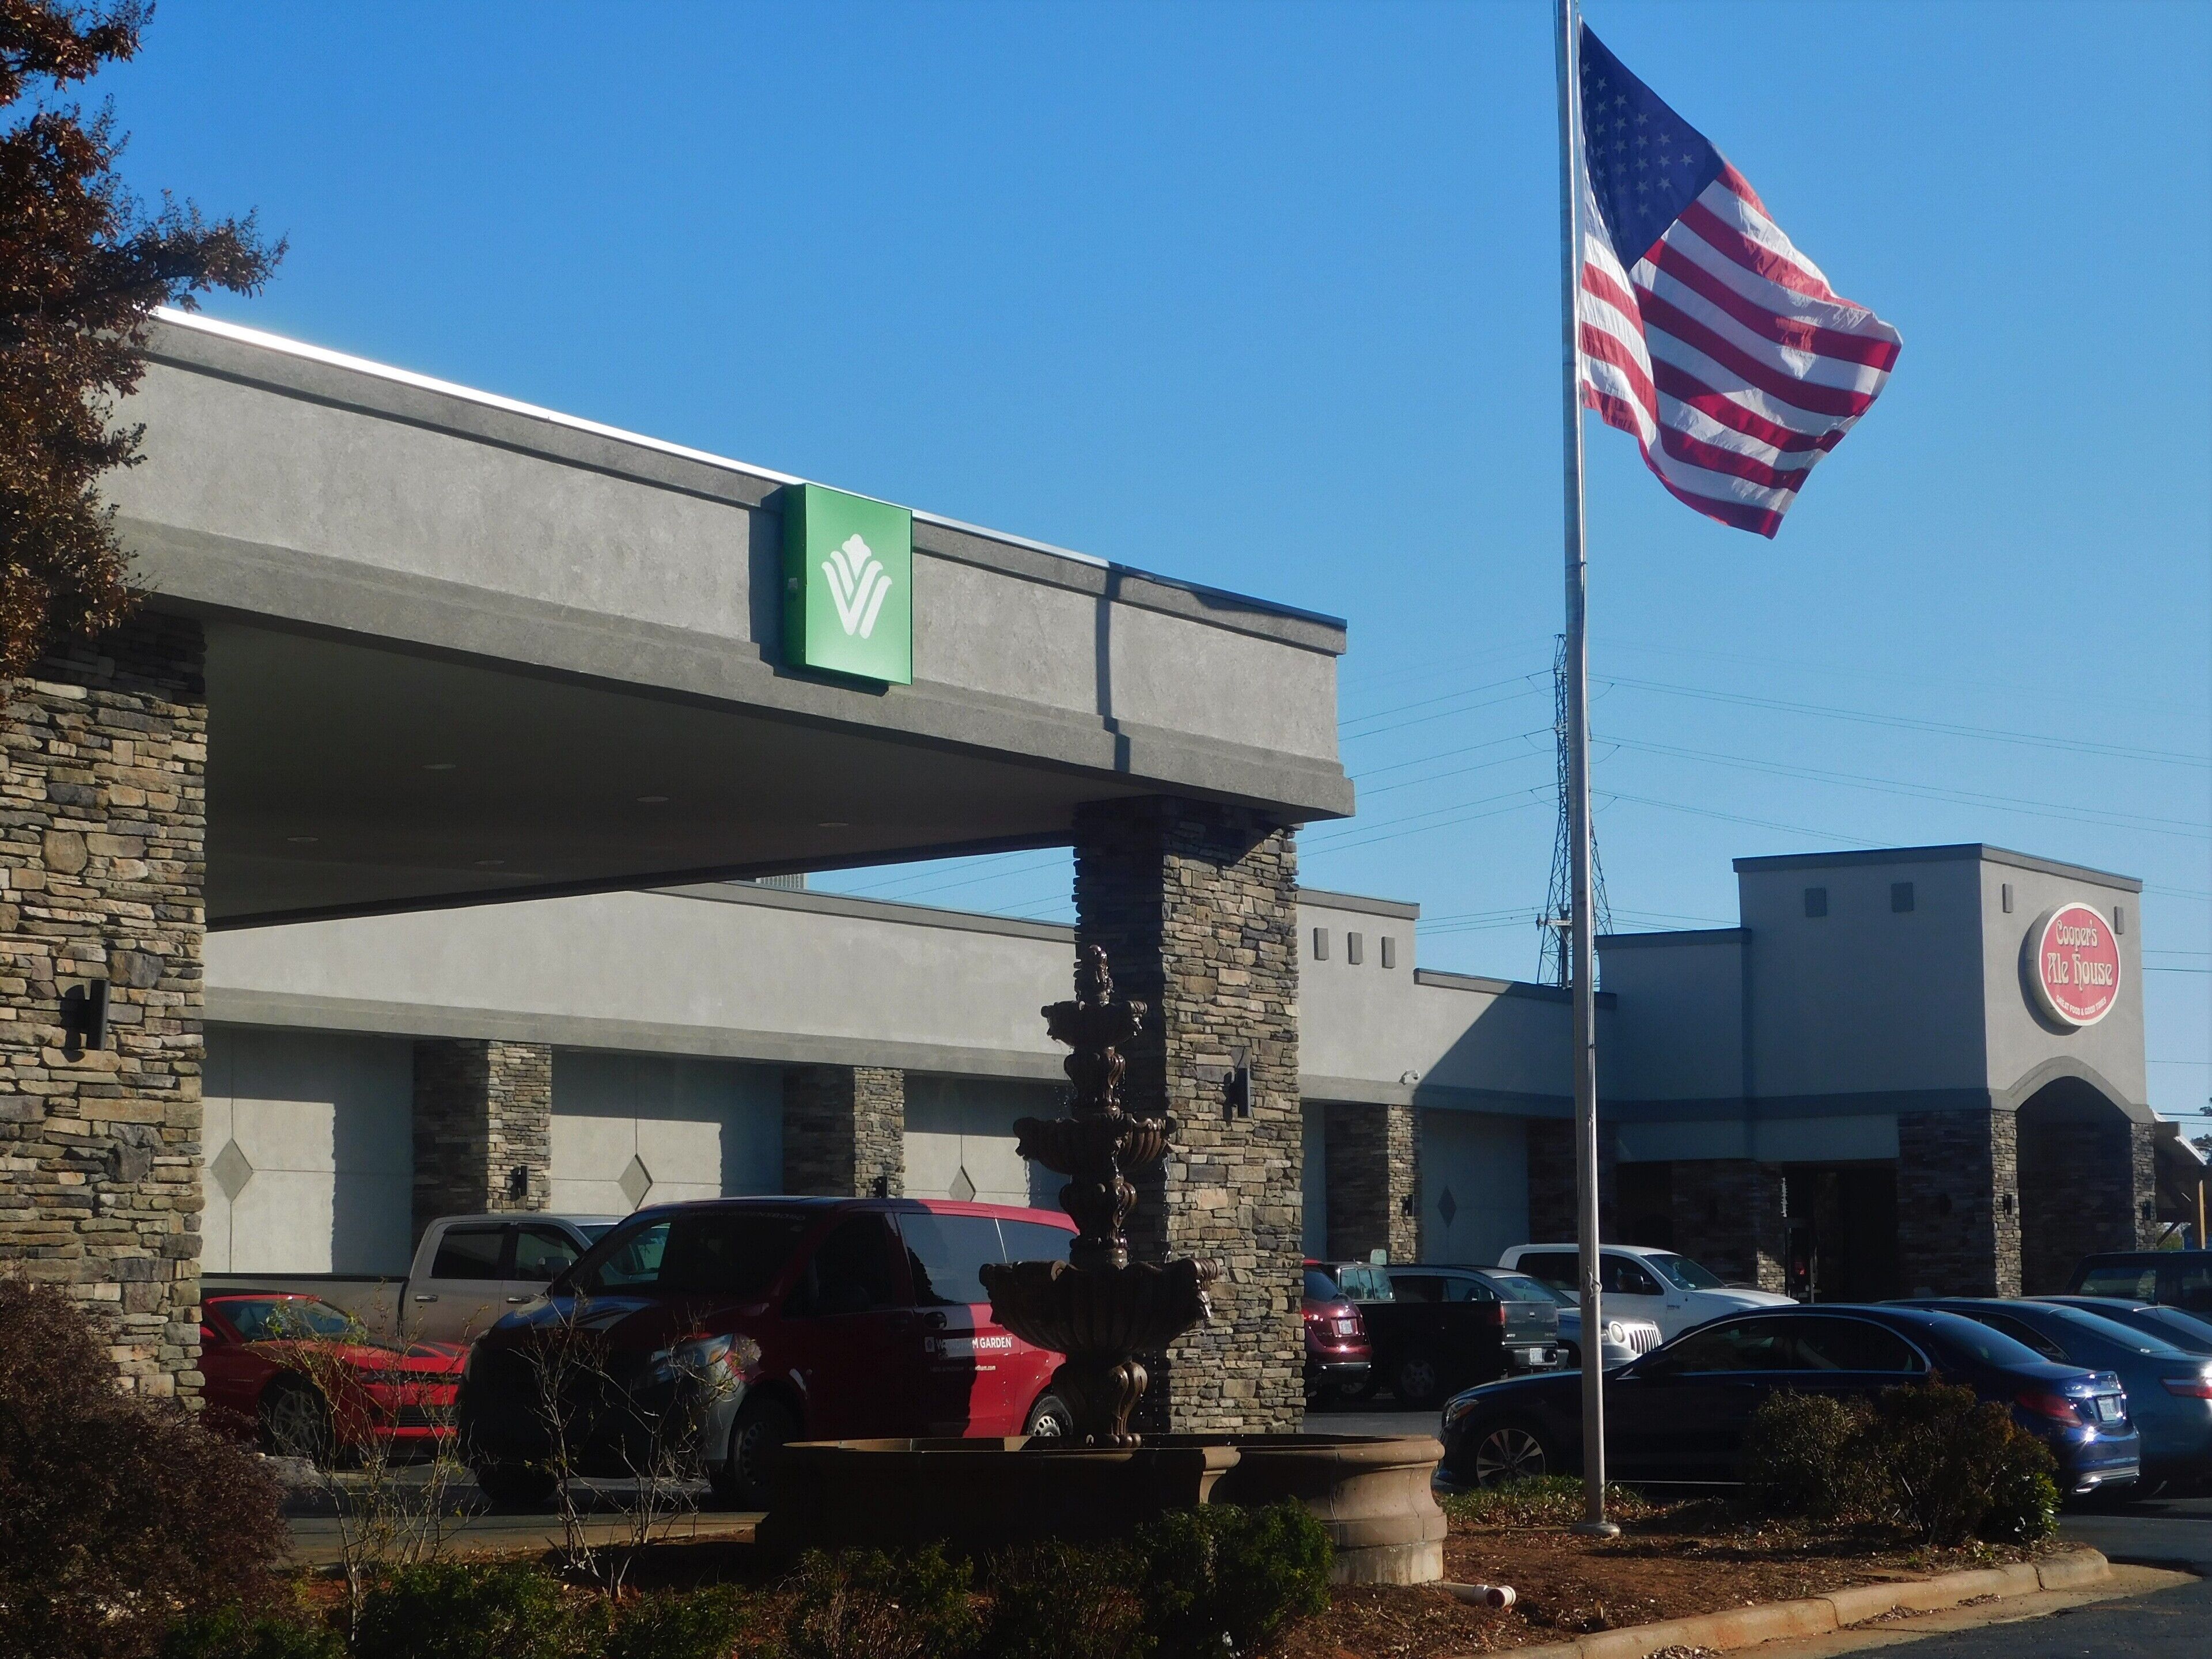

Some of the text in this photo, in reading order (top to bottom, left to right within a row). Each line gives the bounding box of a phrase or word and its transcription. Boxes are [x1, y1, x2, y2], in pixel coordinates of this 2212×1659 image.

[2056, 919, 2098, 951] Cooper's
[2047, 952, 2069, 984] Ale
[2070, 1005, 2081, 1015] FOOD
[979, 1337, 1012, 1349] GARDEN
